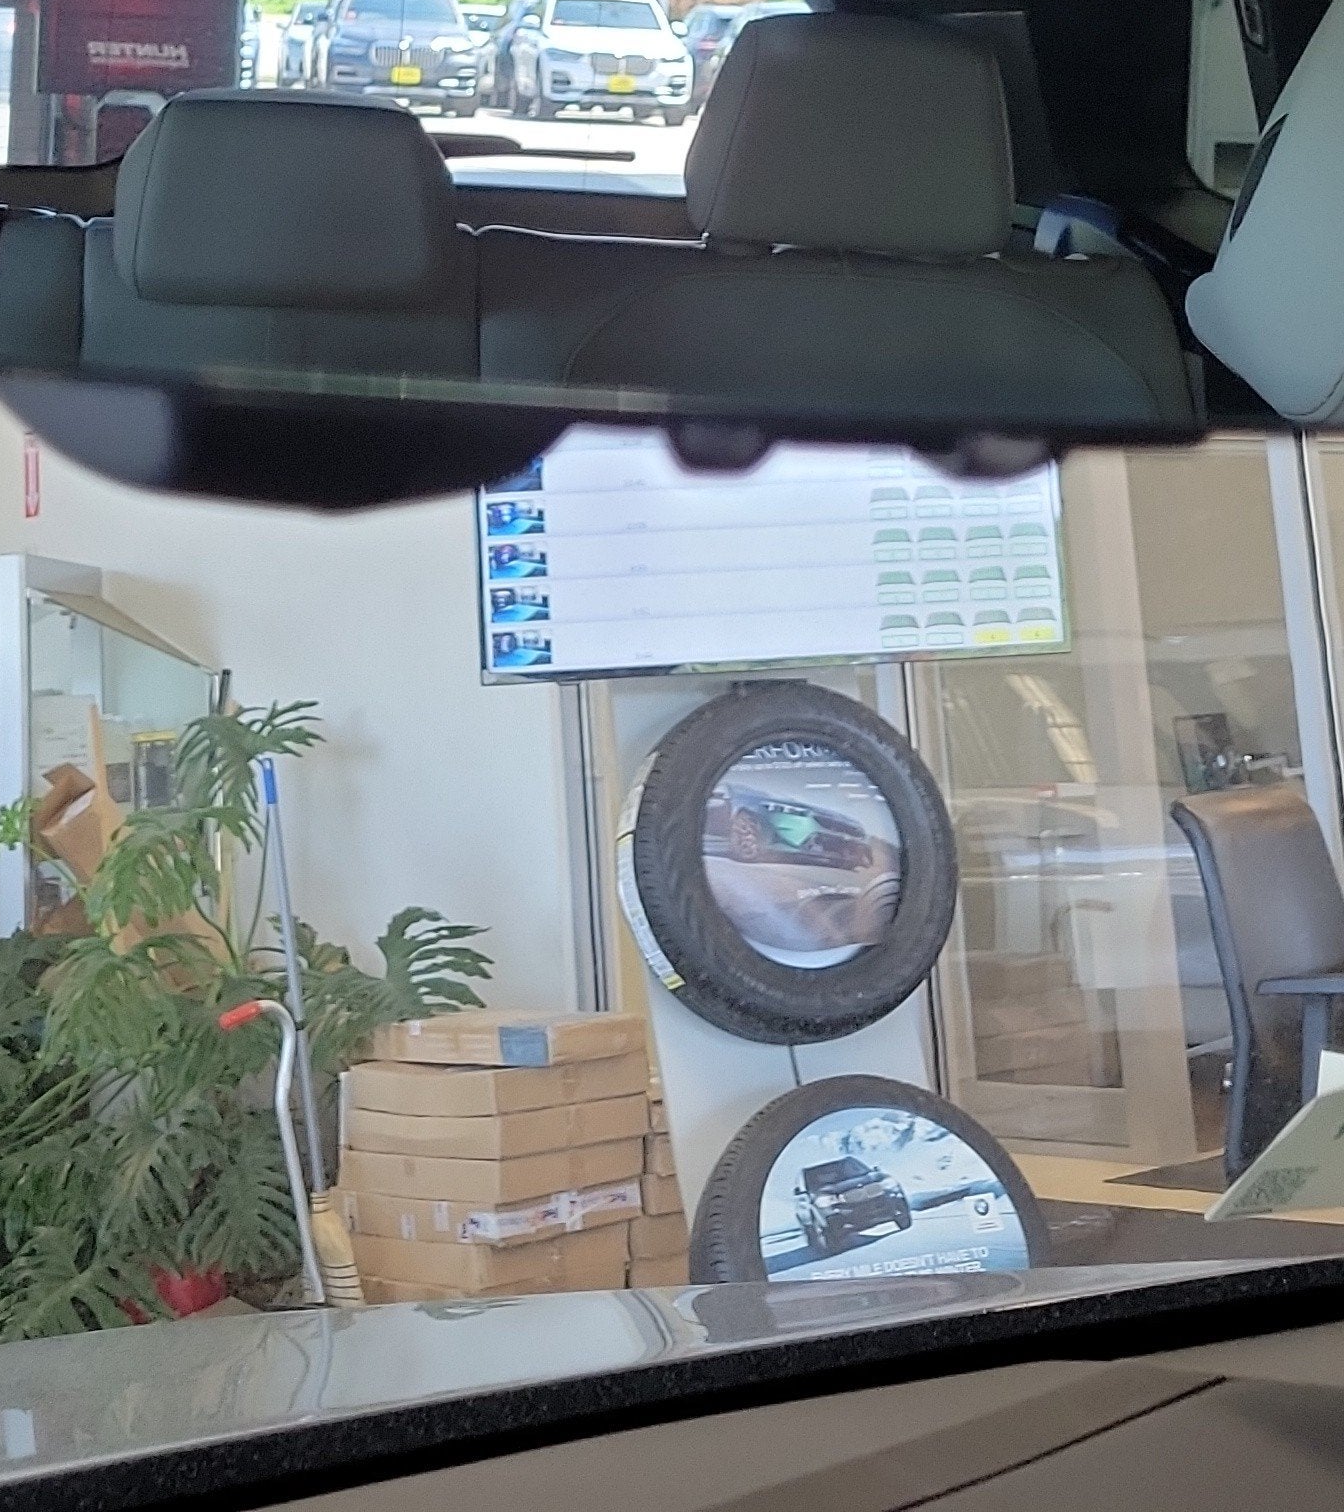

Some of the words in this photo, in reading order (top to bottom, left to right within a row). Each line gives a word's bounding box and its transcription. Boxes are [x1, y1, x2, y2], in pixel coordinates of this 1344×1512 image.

[853, 1262, 883, 1278] MILE
[884, 1253, 934, 1272] DOESN'T
[936, 1250, 971, 1265] HAVE
[971, 1245, 989, 1259] TO
